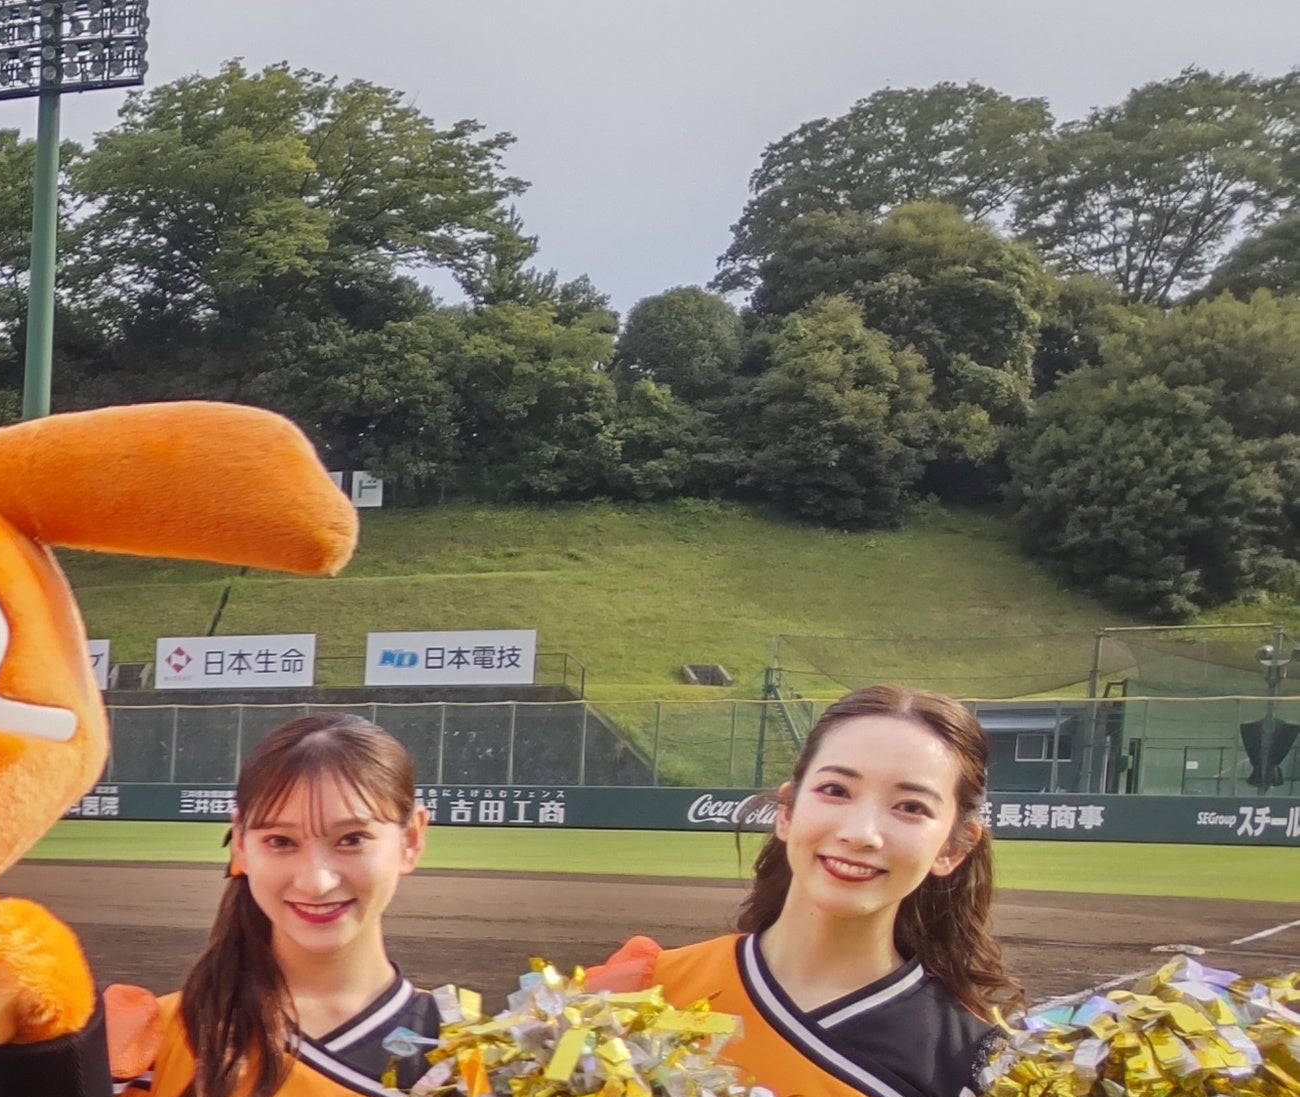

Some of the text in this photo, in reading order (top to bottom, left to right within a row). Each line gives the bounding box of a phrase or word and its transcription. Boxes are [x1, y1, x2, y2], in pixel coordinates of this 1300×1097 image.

[204, 648, 306, 676] 日本生命
[425, 646, 522, 670] 日本電技
[449, 799, 565, 823] 吉田工商
[997, 803, 1105, 829] 長澤商事
[1197, 812, 1237, 828] SEGroup
